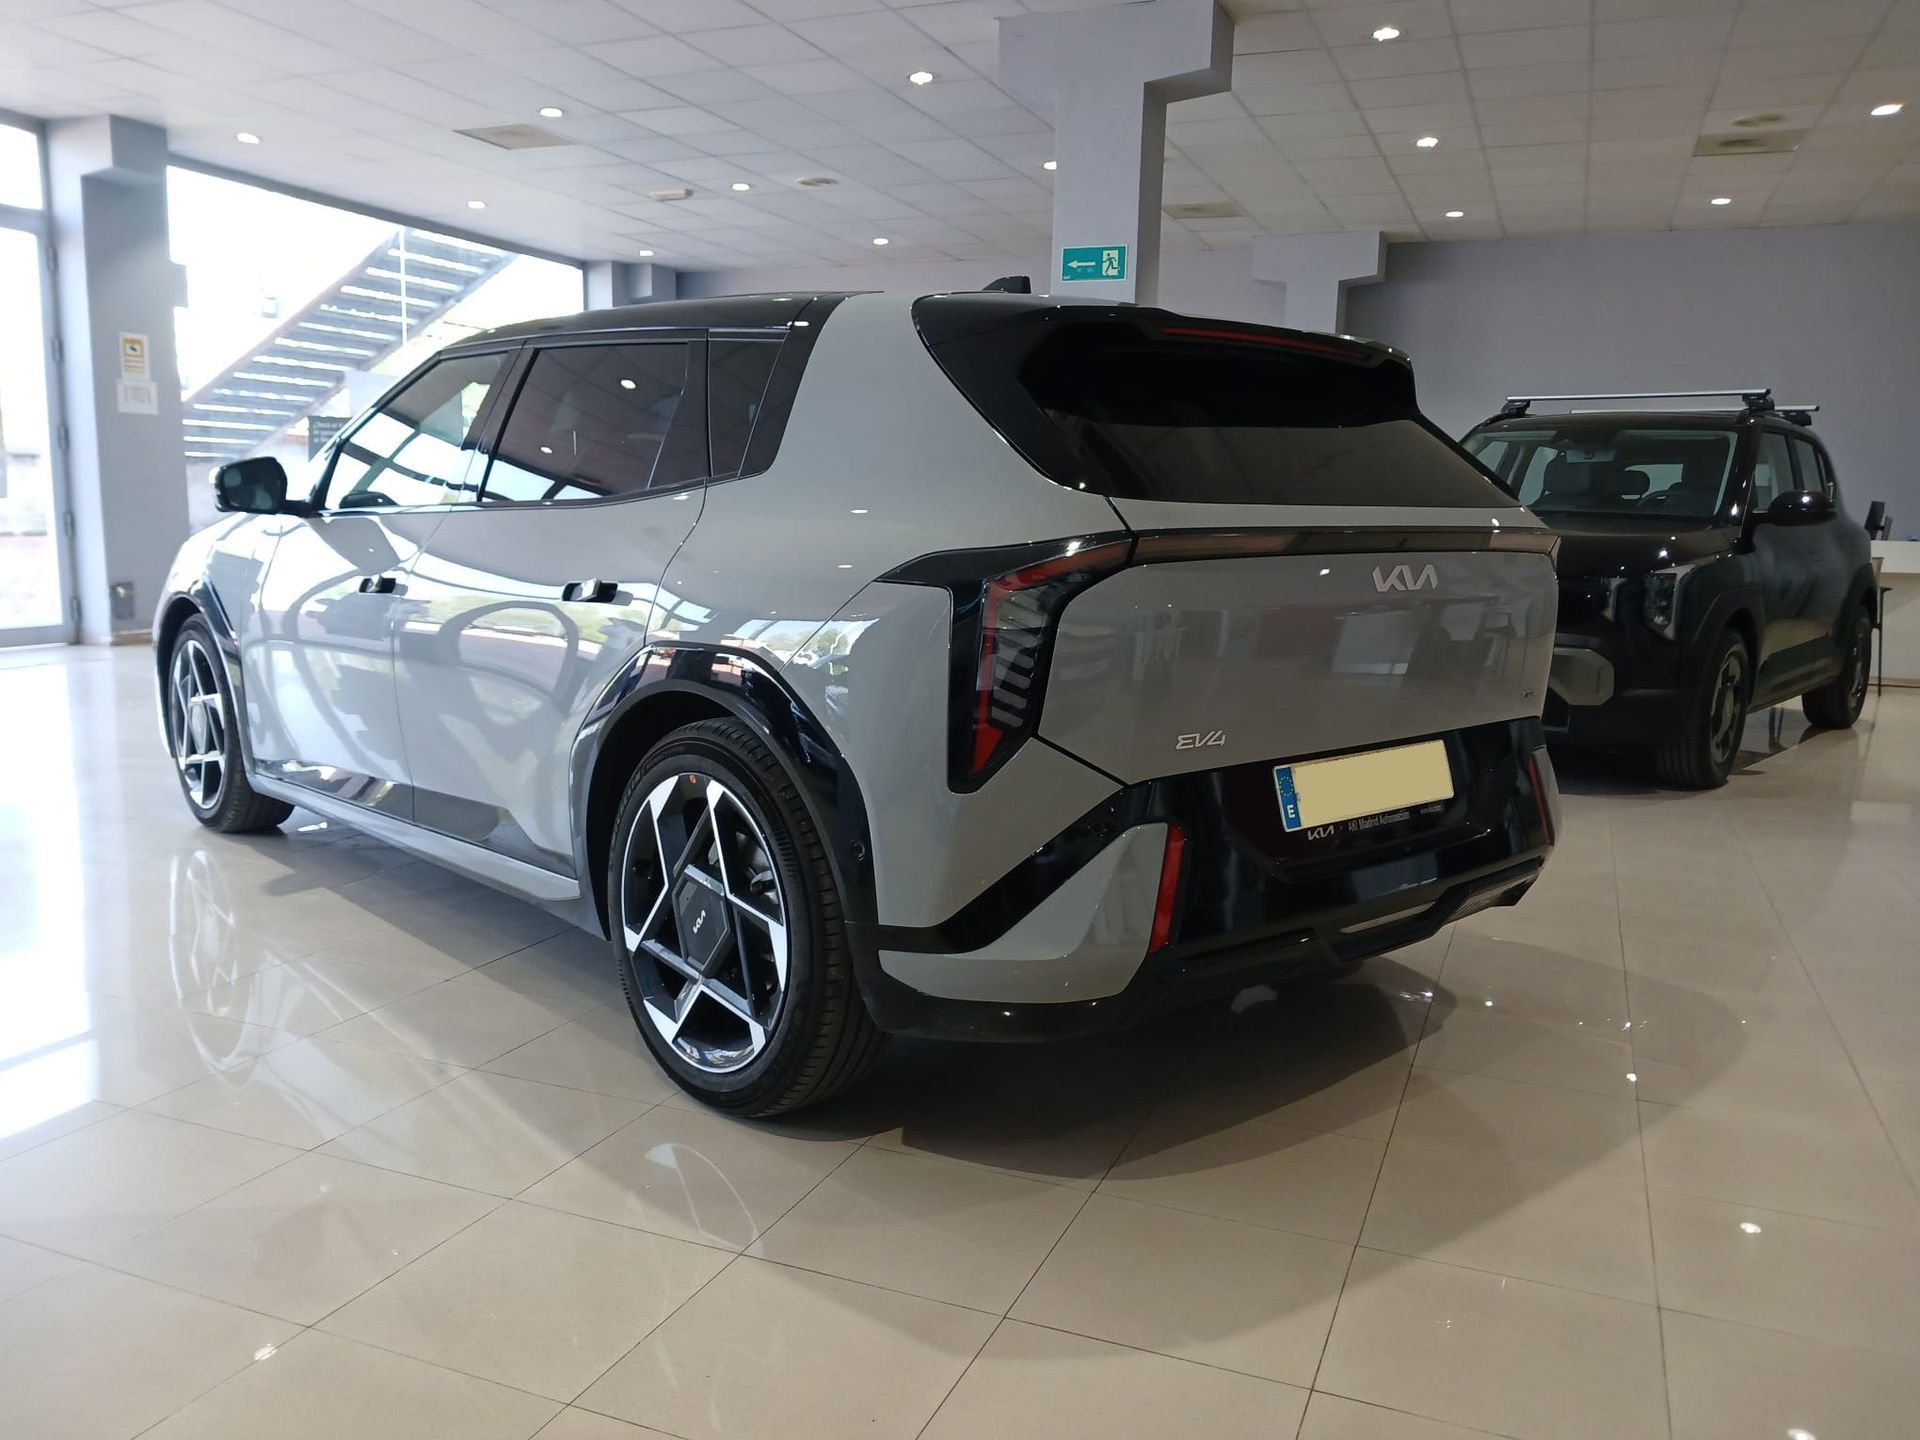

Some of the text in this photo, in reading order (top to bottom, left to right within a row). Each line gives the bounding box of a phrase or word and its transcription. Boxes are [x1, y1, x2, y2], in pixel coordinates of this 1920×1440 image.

[1373, 564, 1438, 592] KIA
[1176, 730, 1225, 749] EV4
[1287, 804, 1295, 818] E
[1308, 825, 1334, 840] KIA
[693, 910, 706, 934] KIA
